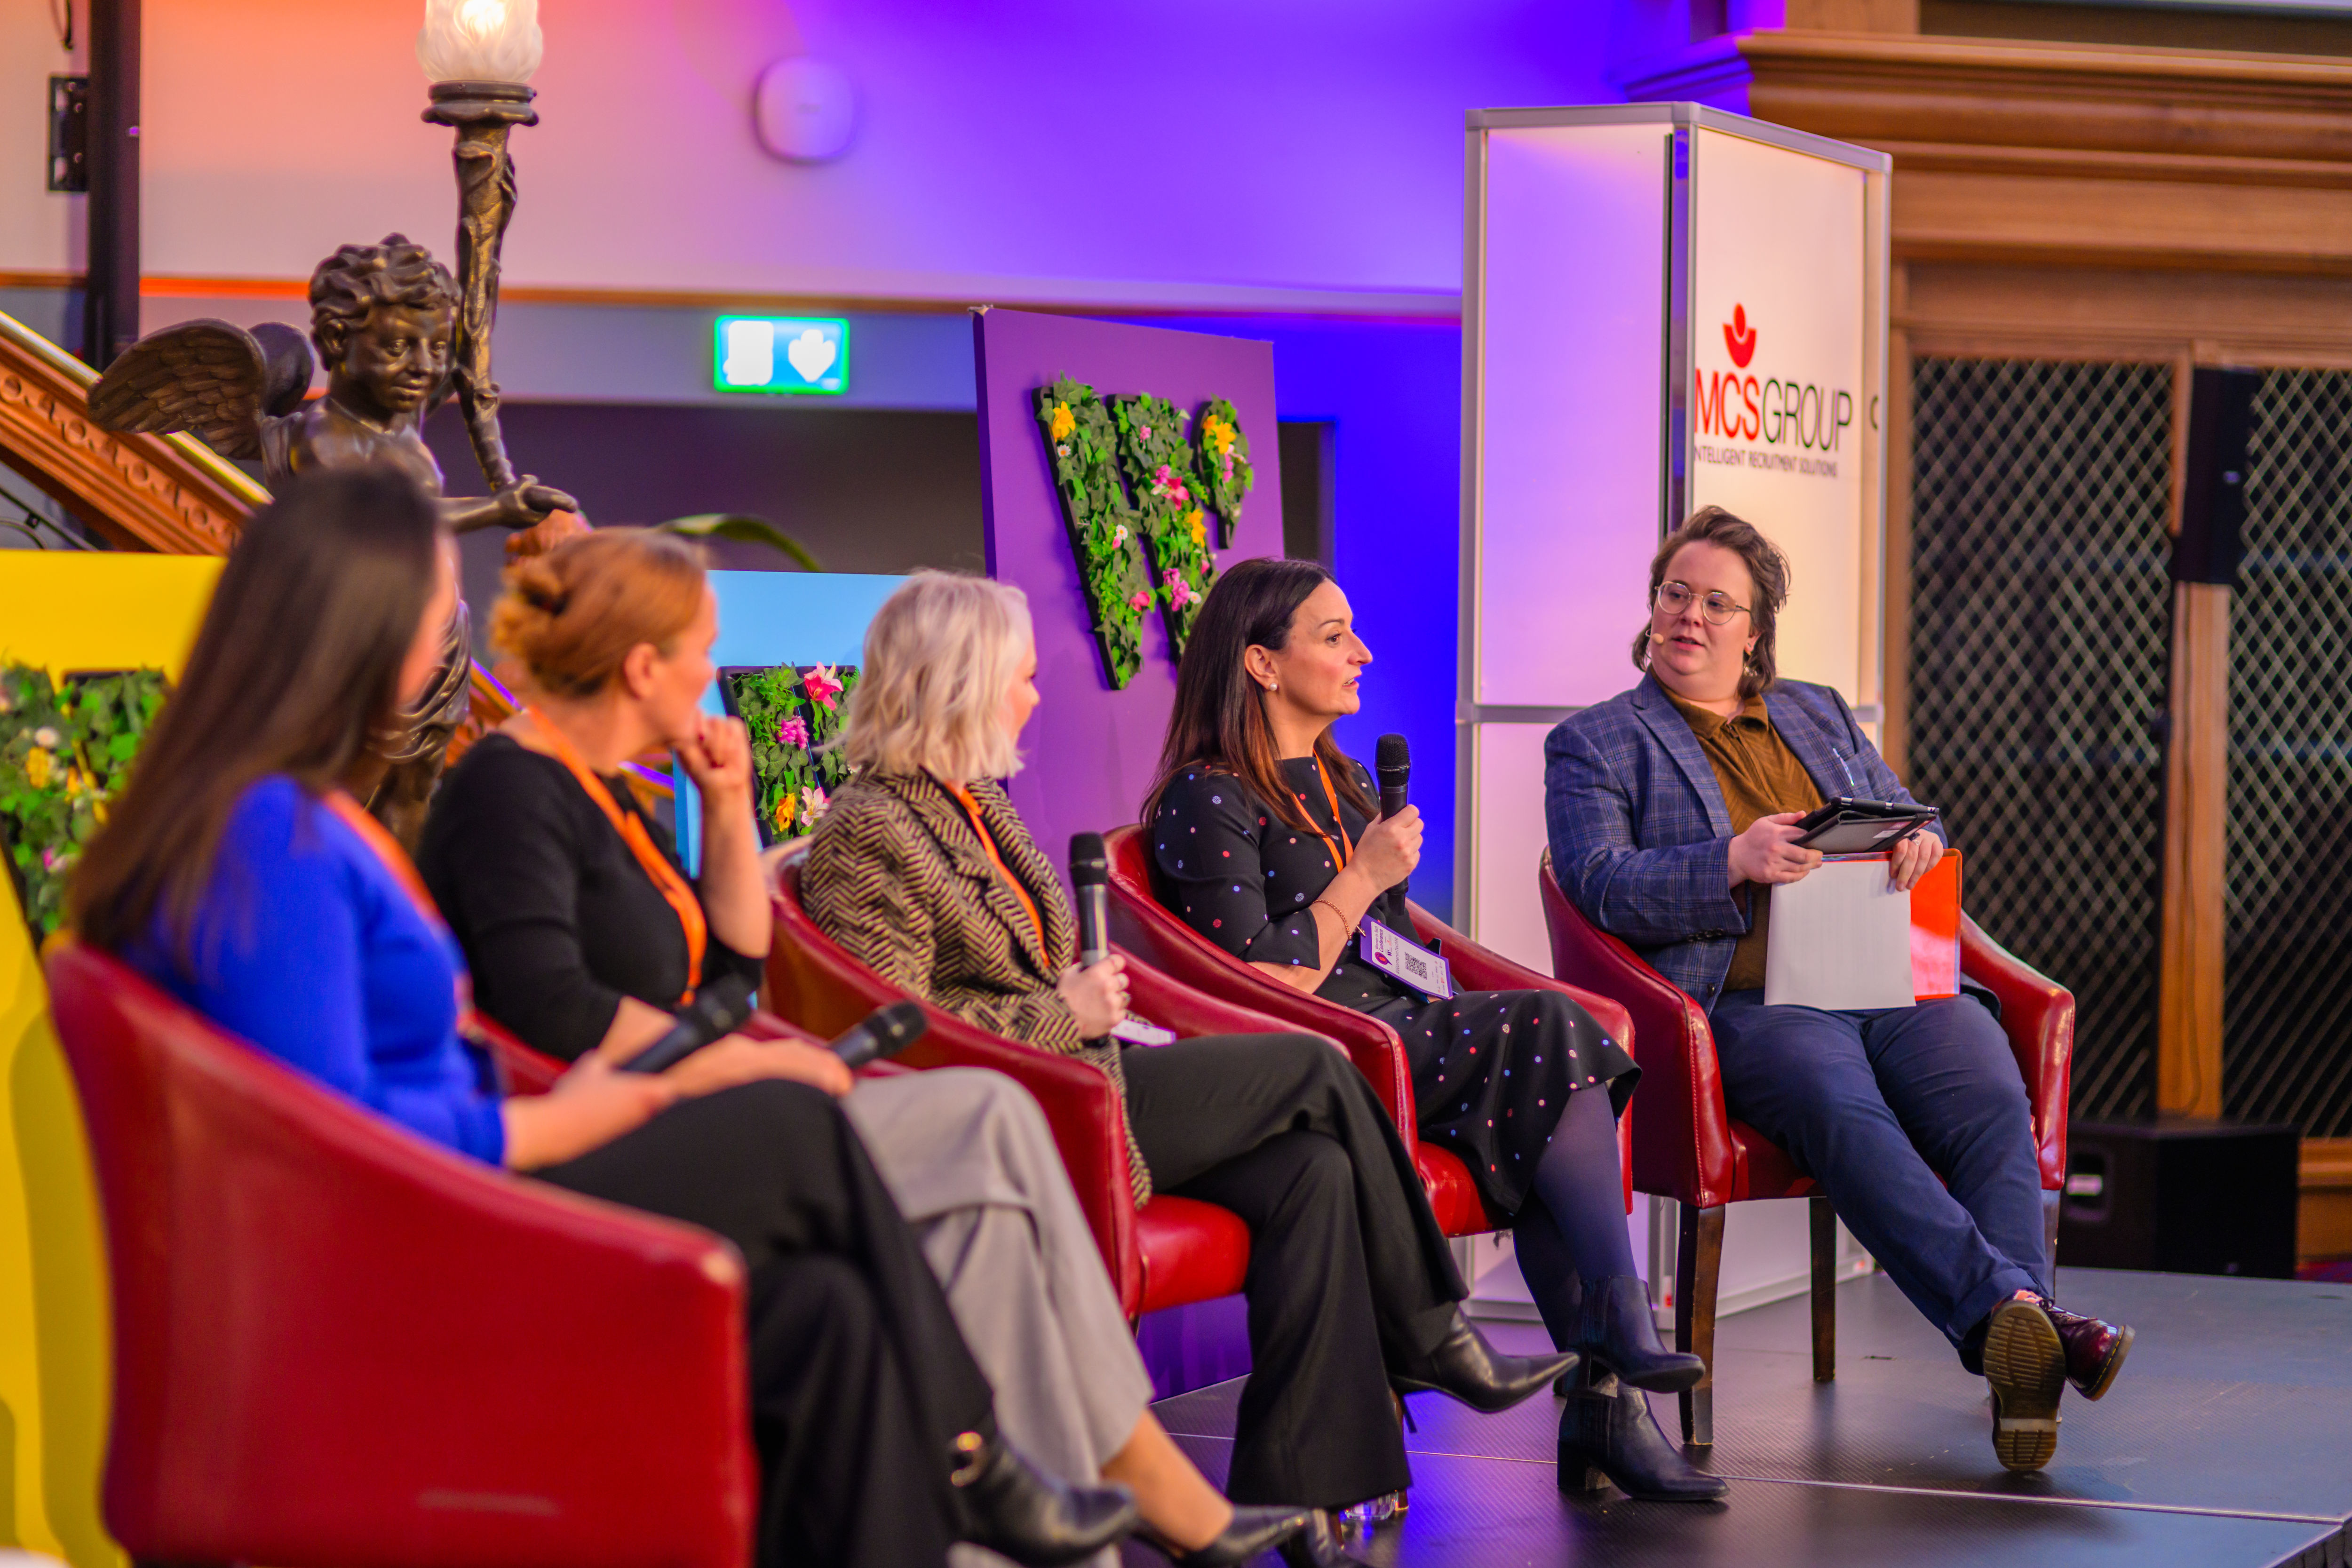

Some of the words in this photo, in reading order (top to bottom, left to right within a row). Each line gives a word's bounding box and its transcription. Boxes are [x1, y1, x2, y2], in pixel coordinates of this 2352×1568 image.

[1693, 445, 1746, 466] NTELLIGENT
[1748, 450, 1797, 472] RECRUITMENT
[1799, 457, 1838, 478] SOLUTIONS
